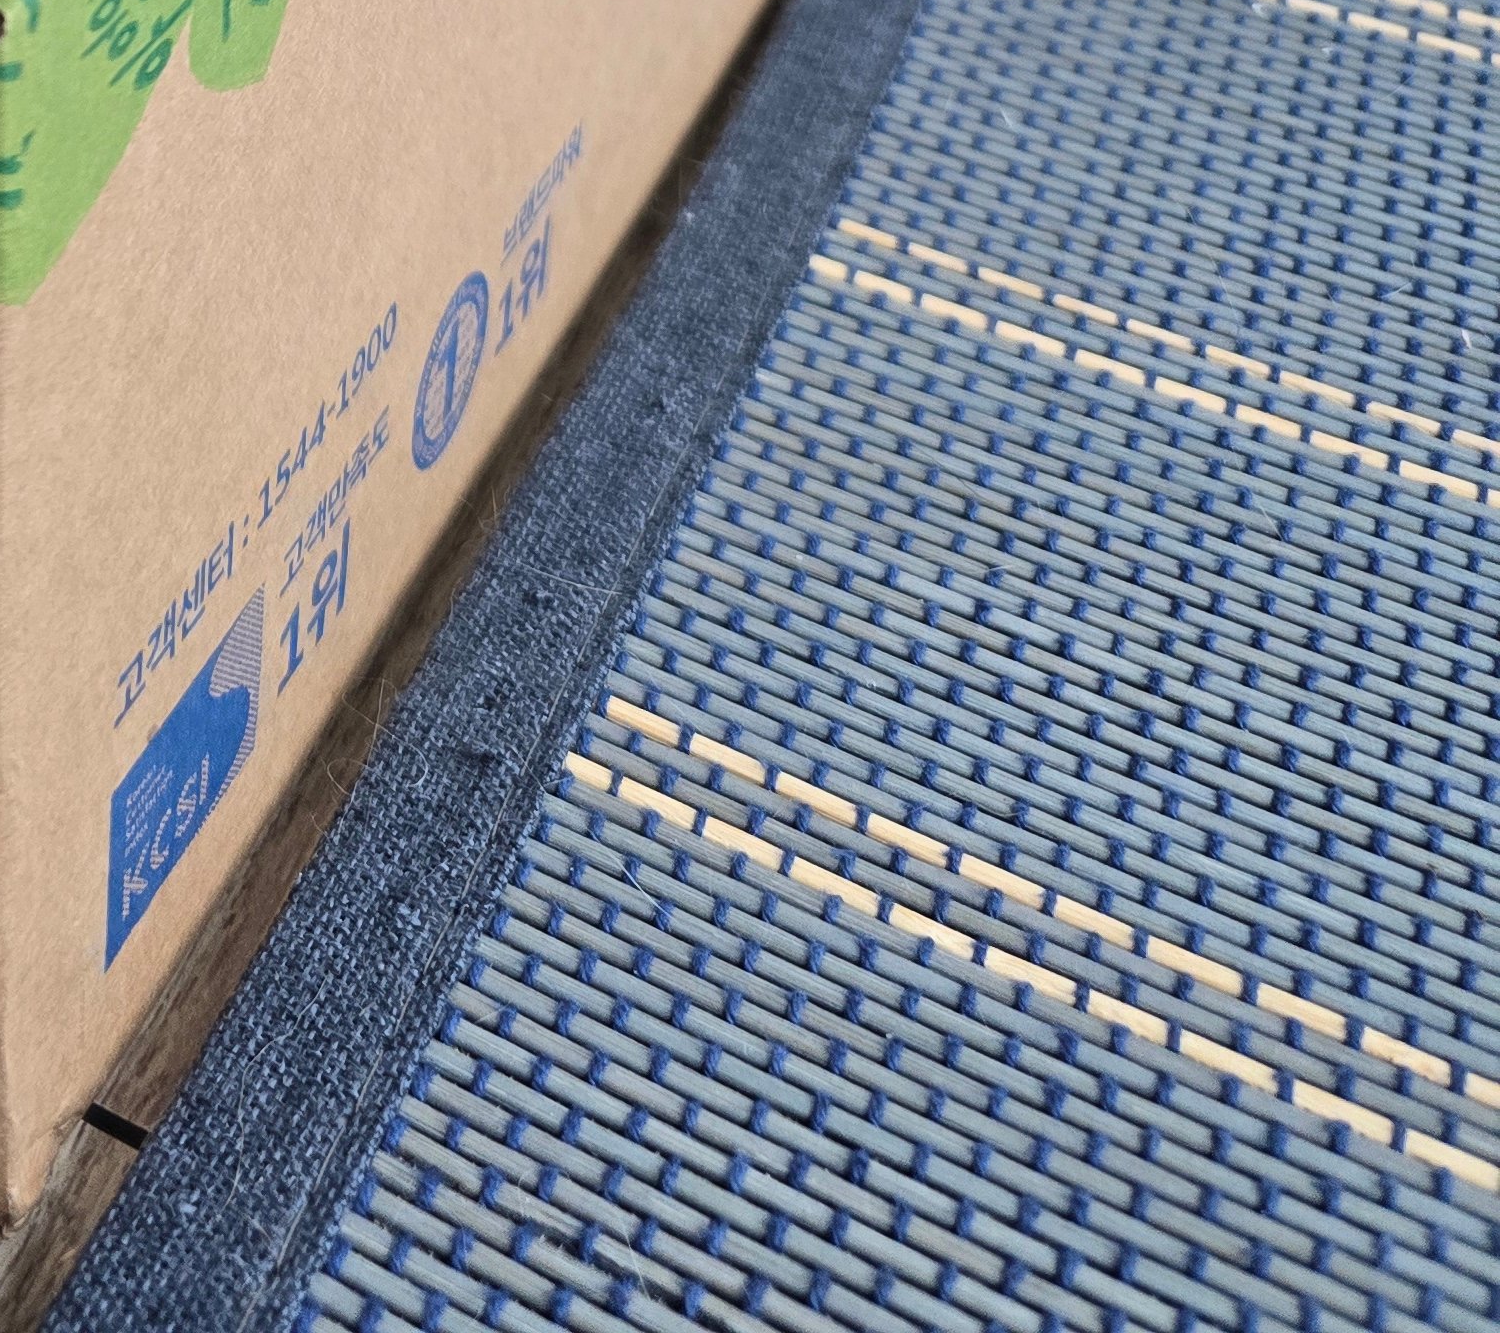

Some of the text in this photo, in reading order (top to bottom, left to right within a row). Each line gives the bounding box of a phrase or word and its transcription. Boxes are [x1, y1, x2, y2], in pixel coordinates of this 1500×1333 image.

[494, 213, 552, 357] 1위
[113, 520, 235, 729] 고객센터
[257, 300, 397, 530] 1544-1900
[280, 404, 390, 598] 고객만족도
[277, 517, 351, 698] 1위
[122, 751, 211, 921] KCSI
